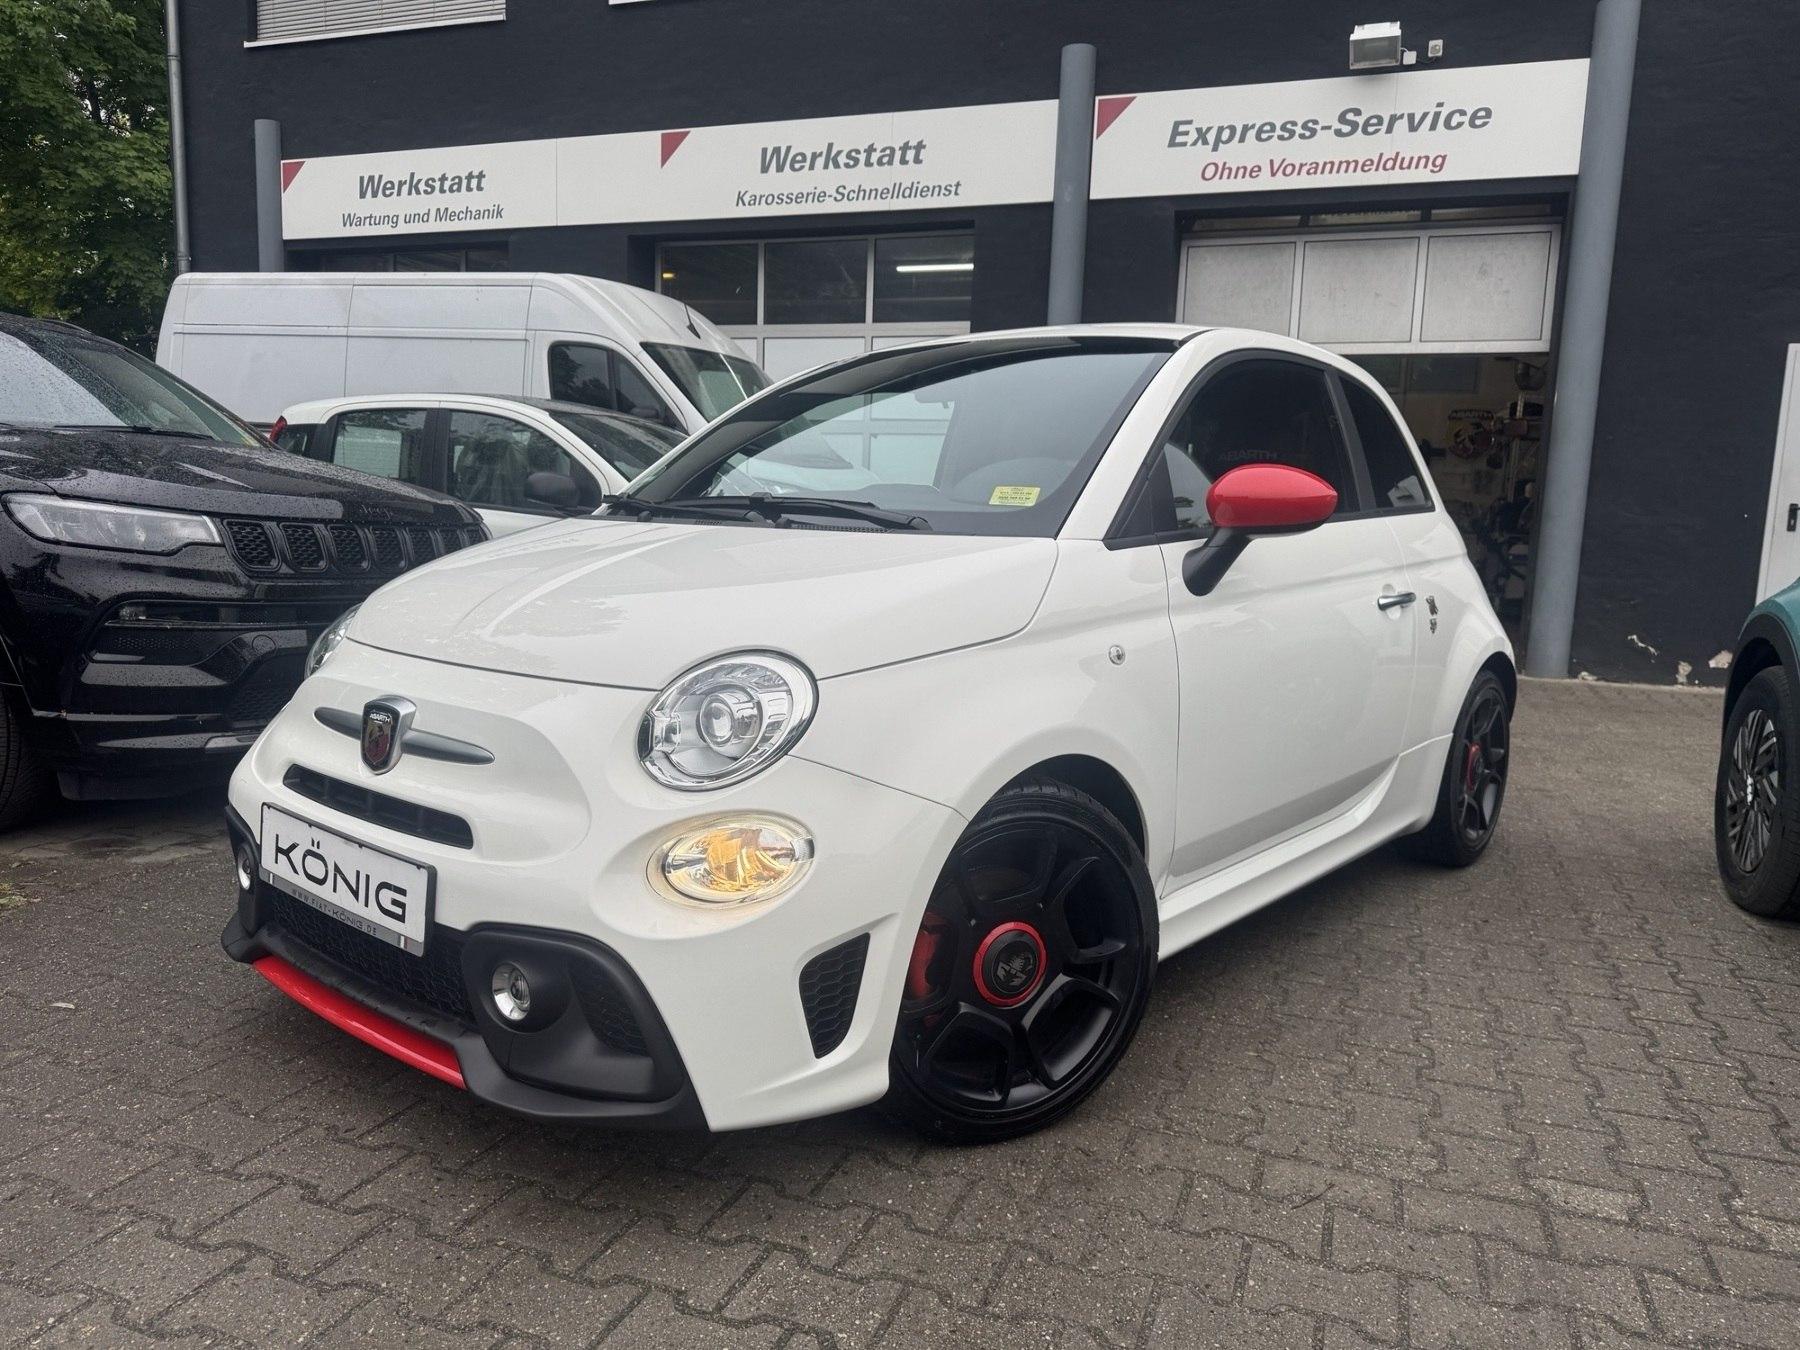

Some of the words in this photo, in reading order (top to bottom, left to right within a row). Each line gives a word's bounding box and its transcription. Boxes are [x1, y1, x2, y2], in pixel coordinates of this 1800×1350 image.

[1167, 101, 1493, 152] Express-Service
[760, 139, 926, 174] Werkstatt
[1200, 161, 1262, 181] Ohne
[1269, 151, 1448, 178] Voranmeldung
[358, 169, 486, 199] Werkstatt
[735, 180, 962, 207] Karosserie-Schnelldienst
[341, 211, 399, 228] Wartung
[404, 208, 431, 224] und
[435, 204, 504, 222] Mechanik
[275, 834, 408, 923] KÖNIG
